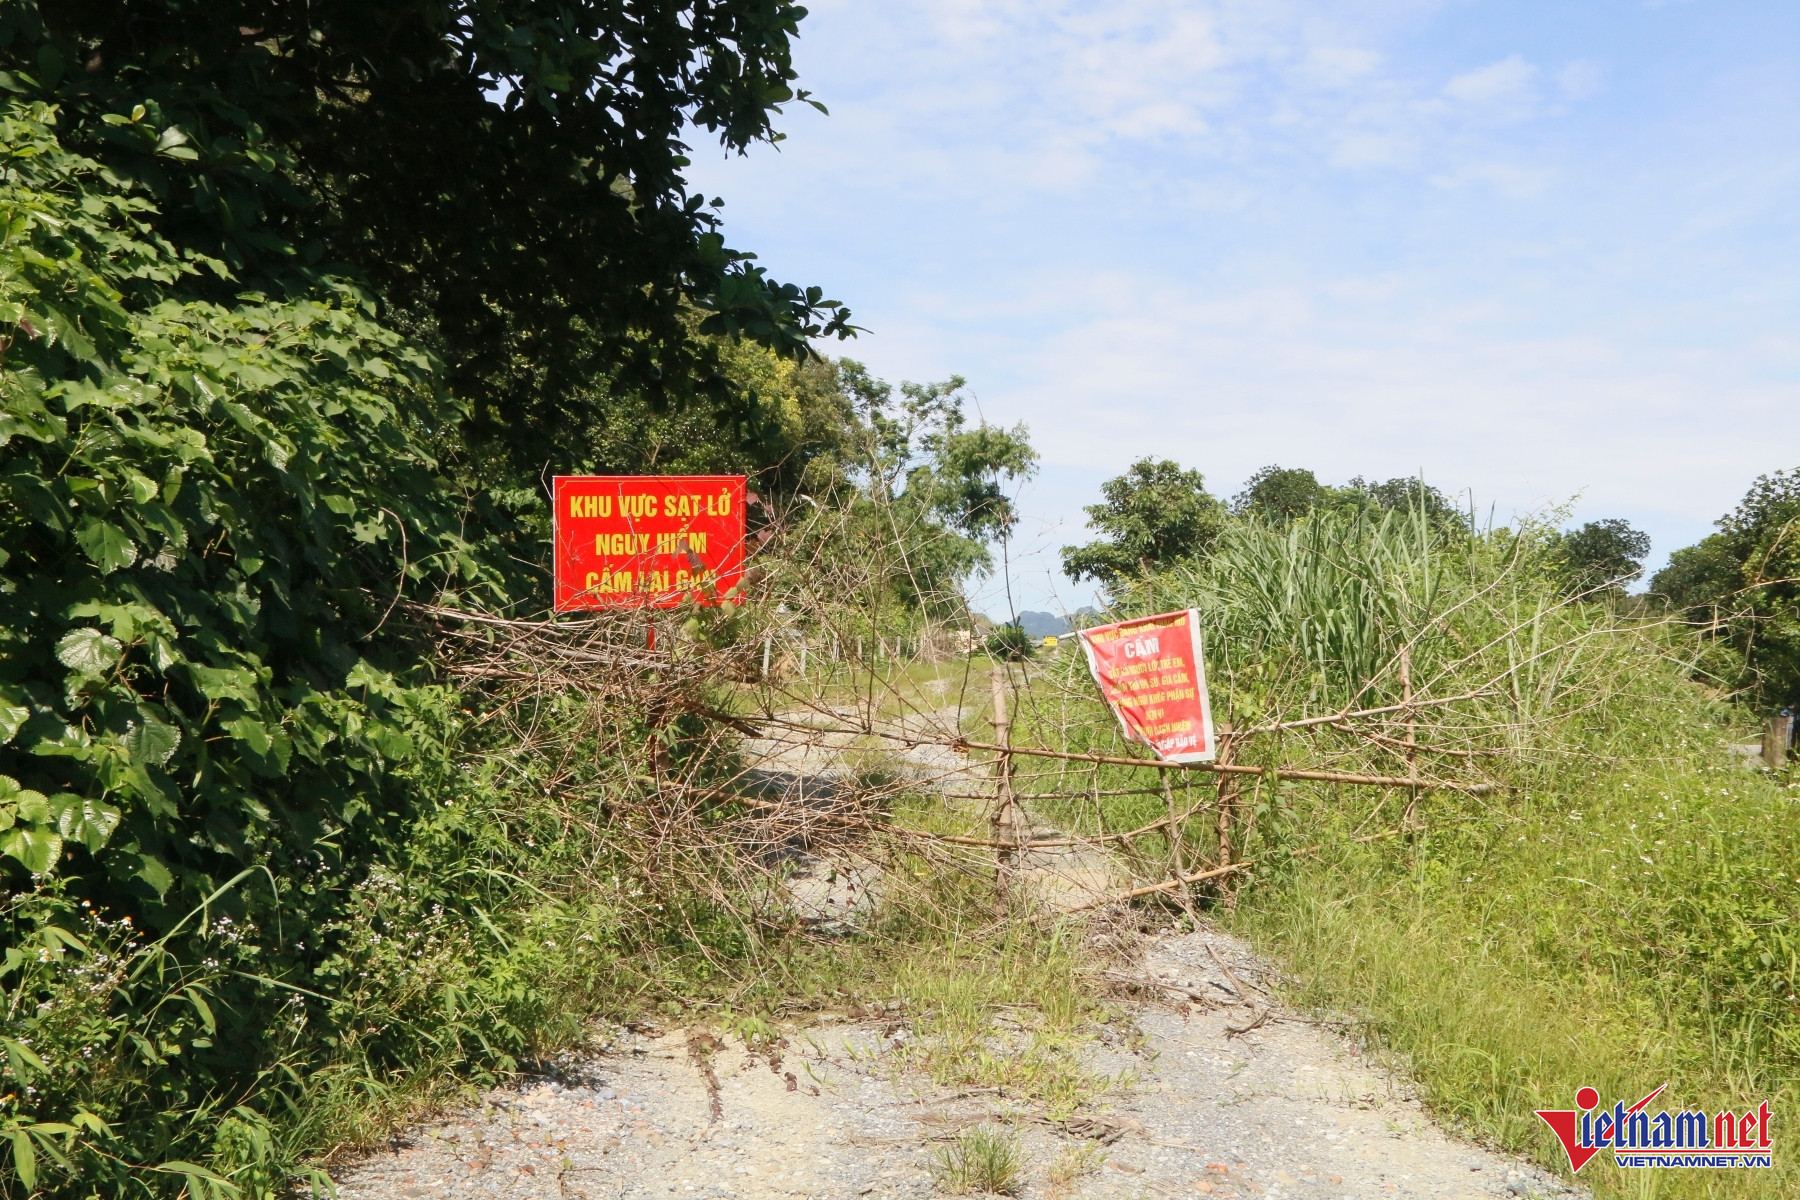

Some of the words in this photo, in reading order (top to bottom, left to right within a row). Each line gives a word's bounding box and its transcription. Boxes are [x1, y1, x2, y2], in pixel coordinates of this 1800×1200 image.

[570, 495, 612, 518] KHU
[618, 493, 658, 522] VỰC
[664, 495, 702, 522] SẠT
[707, 487, 732, 517] LỞ
[595, 533, 650, 555] NGUY
[656, 523, 707, 555] HIỂM
[585, 563, 632, 594] CẤM
[1124, 635, 1160, 659] CẤM
